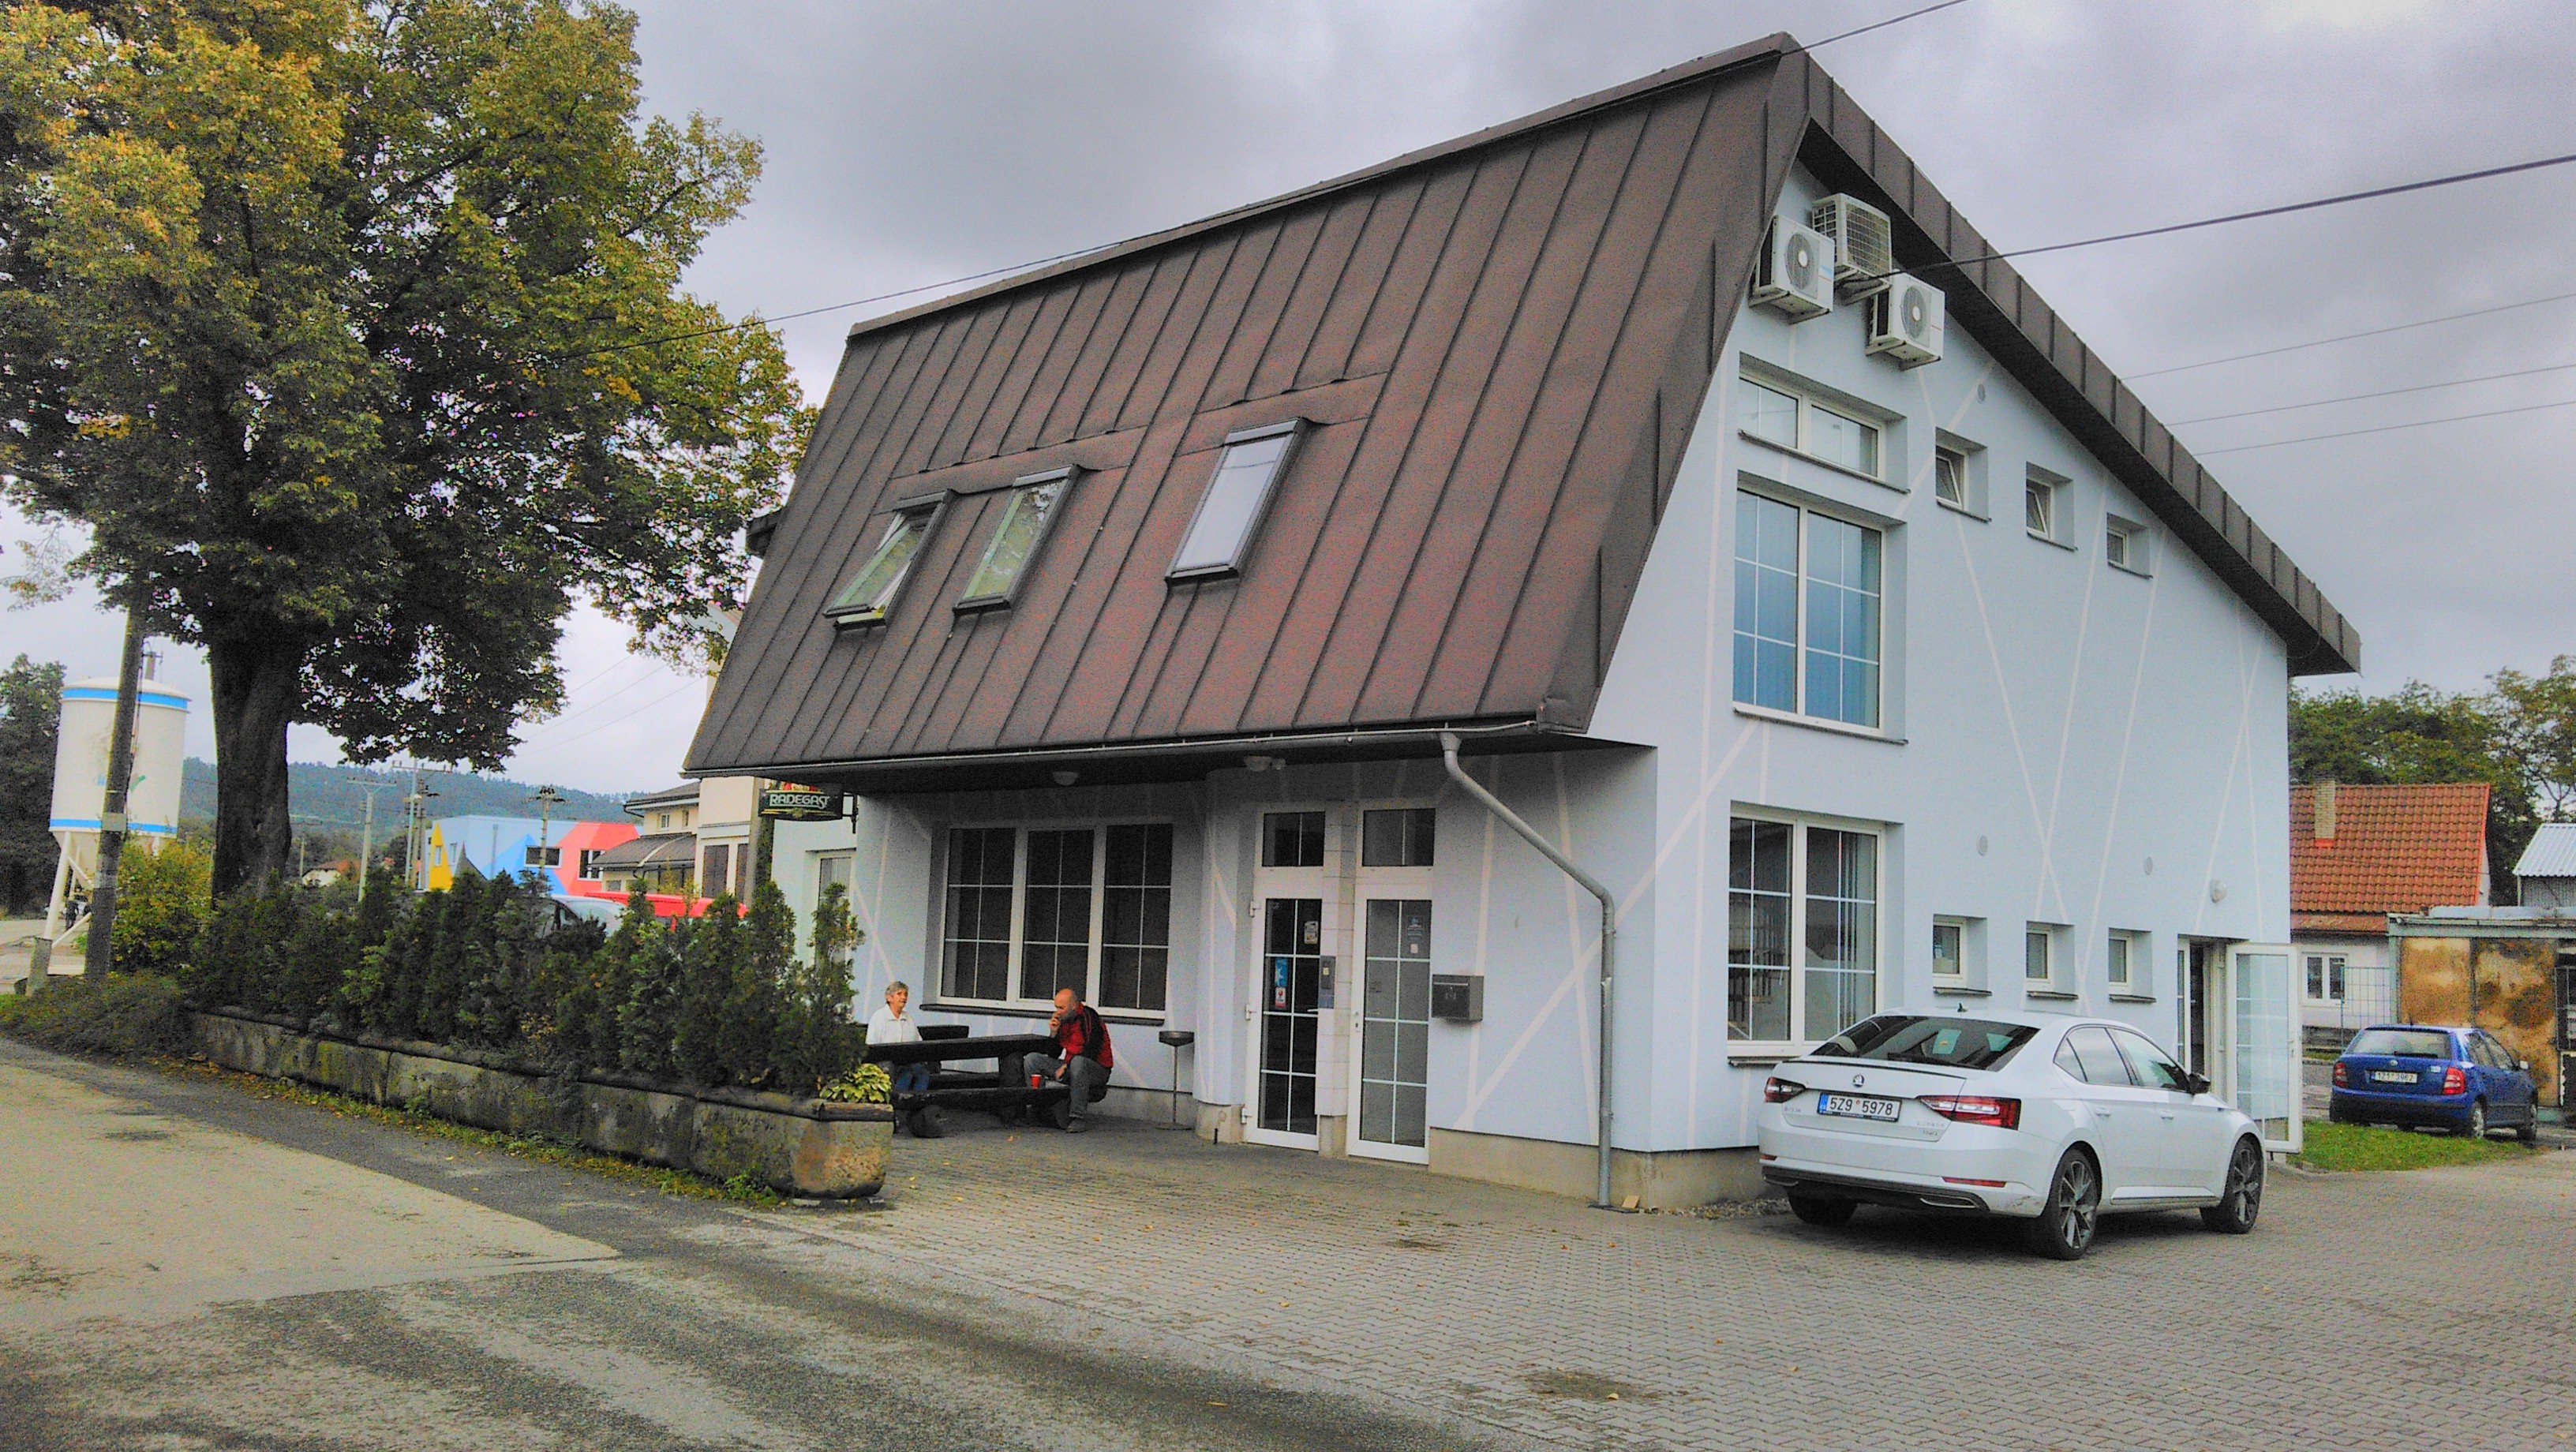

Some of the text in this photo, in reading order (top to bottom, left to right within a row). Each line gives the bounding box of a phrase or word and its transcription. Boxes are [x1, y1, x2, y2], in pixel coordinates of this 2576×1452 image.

[769, 794, 829, 810] RADEGAST
[1829, 1097, 1853, 1112] 5Z9
[1862, 1100, 1893, 1116] 5978
